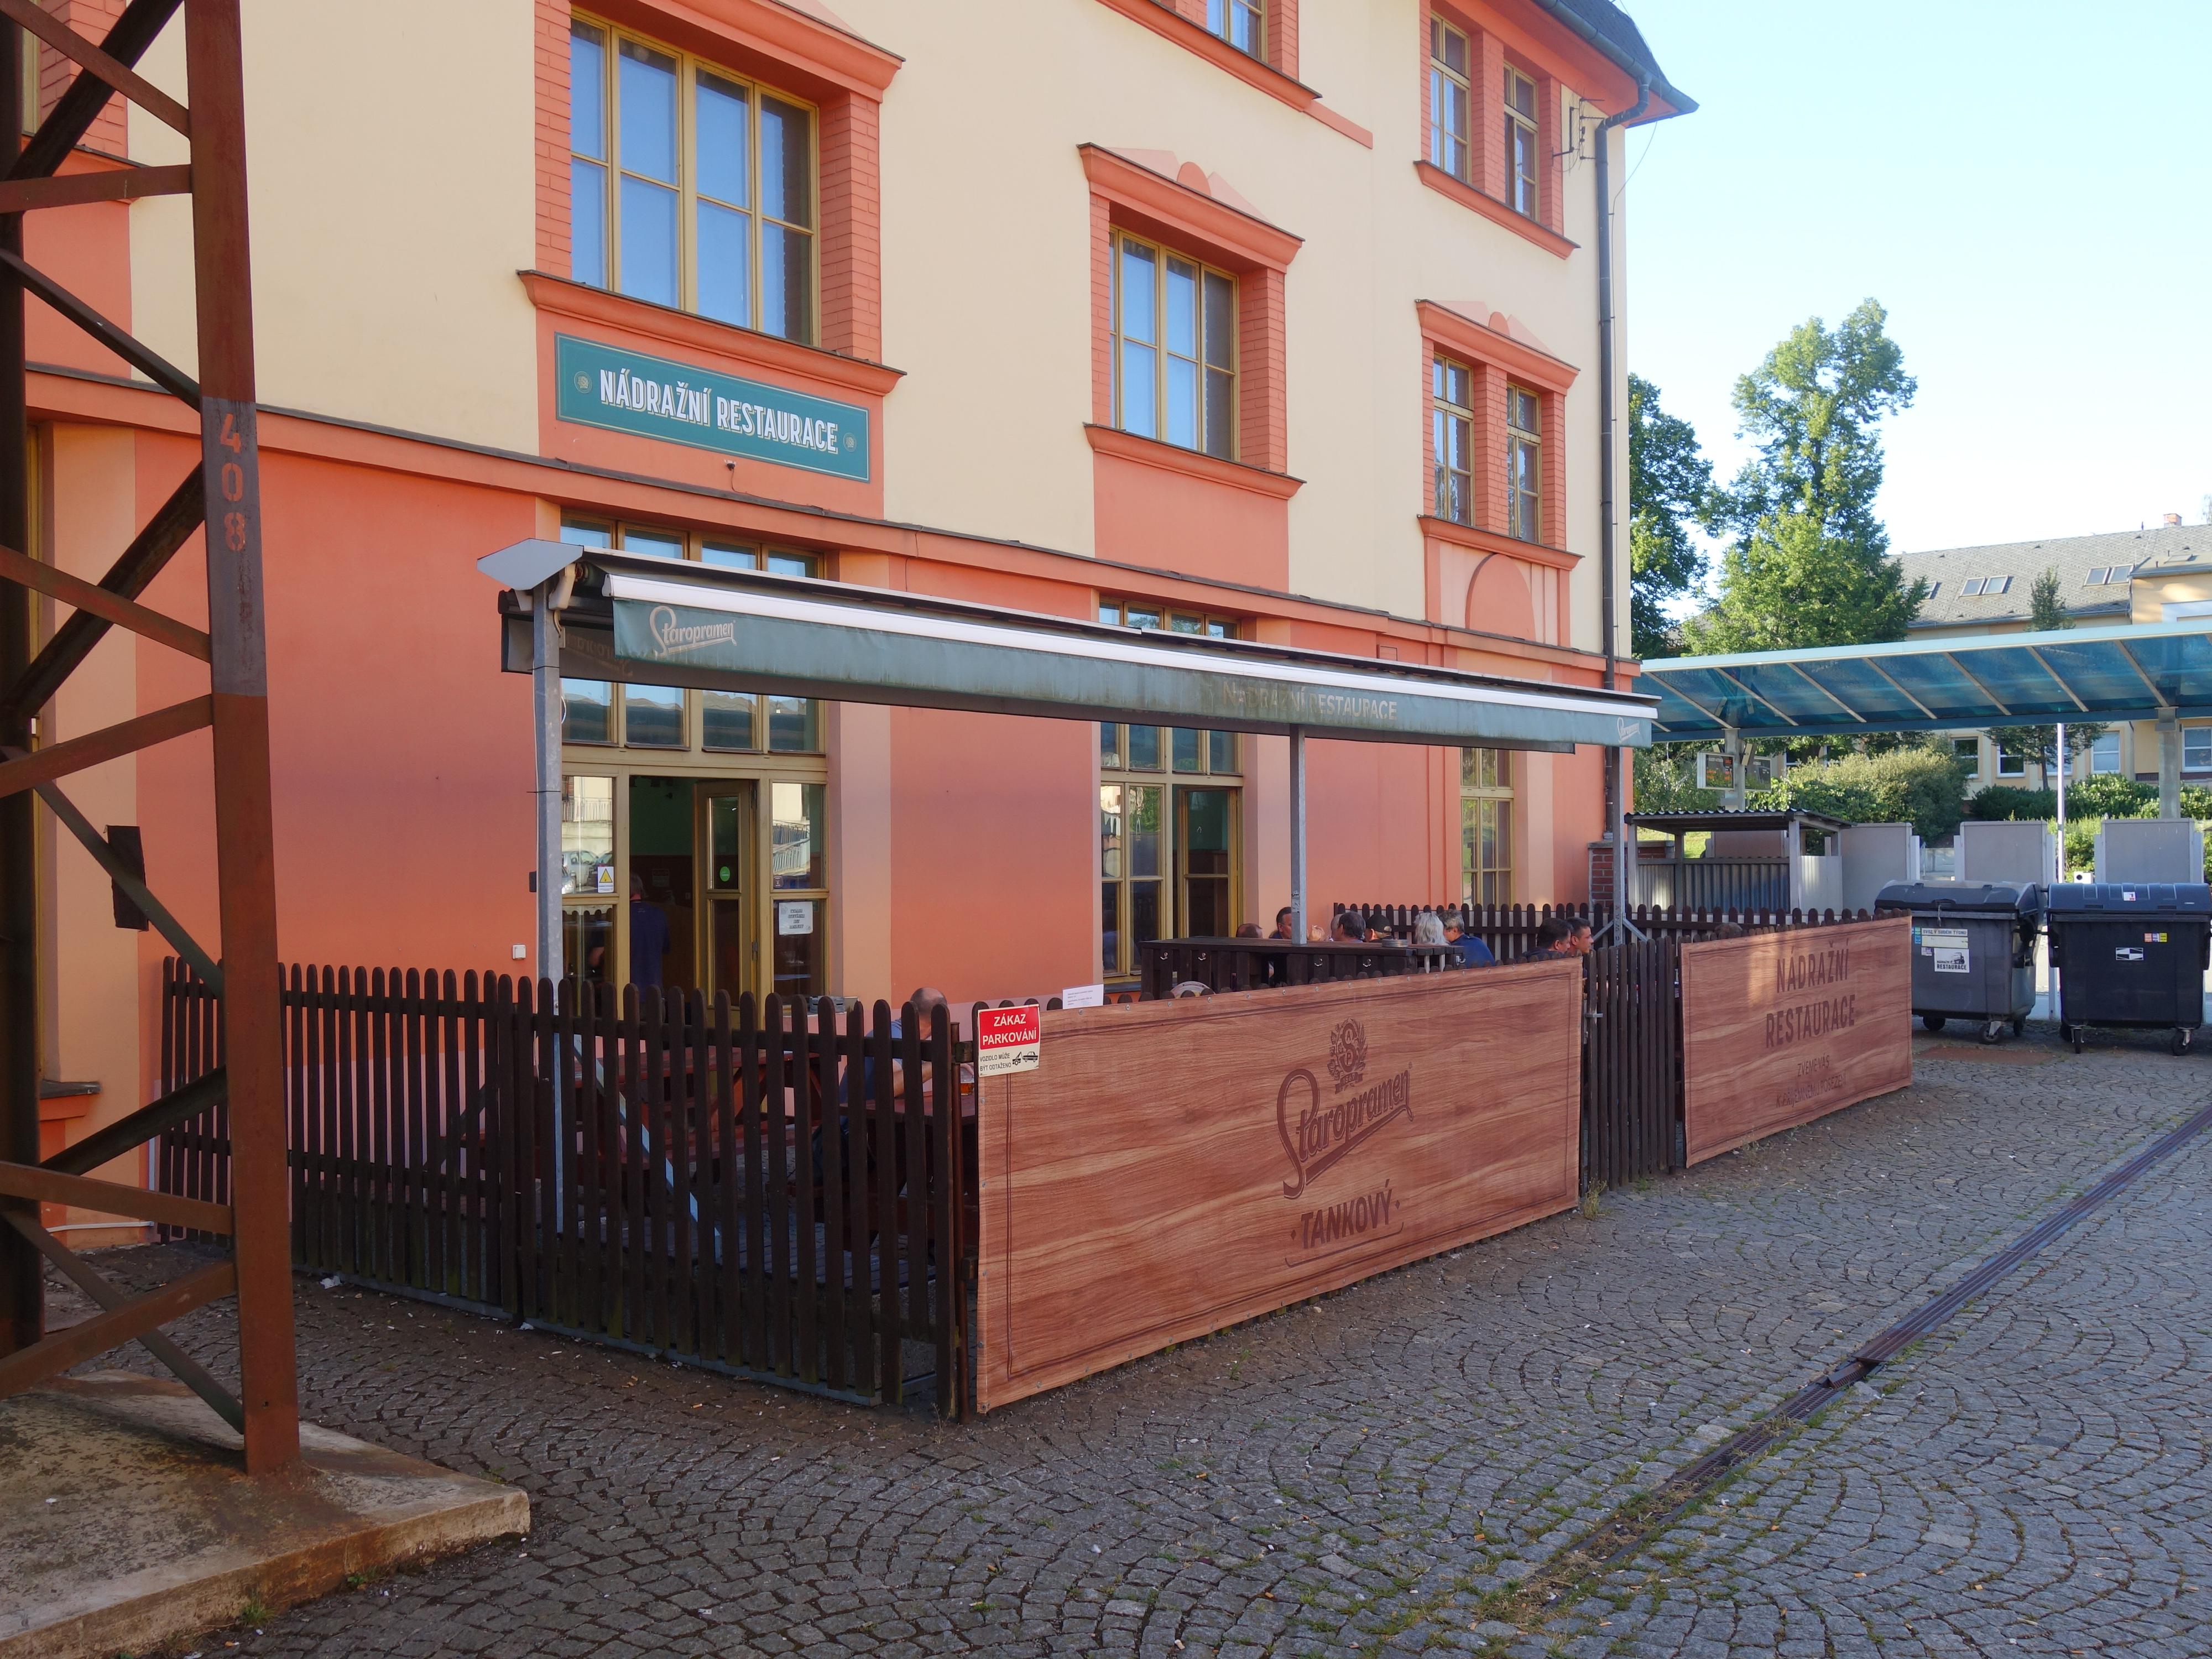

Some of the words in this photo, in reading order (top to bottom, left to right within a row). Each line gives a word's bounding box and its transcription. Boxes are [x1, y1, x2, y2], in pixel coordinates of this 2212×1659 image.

[601, 368, 711, 427] NÁDRAŽNÍ
[717, 397, 838, 454] RESTAURACE
[220, 413, 247, 552] 408
[649, 606, 737, 656] Staropramen
[1309, 693, 1398, 721] RESTAURACE
[1777, 938, 1849, 993] NÁDRAŽNÍ
[982, 1027, 1037, 1046] PARKOVÁNÍ
[993, 1013, 1026, 1027] ZÁKAZ
[1766, 994, 1856, 1048] RESTAURACE
[989, 1062, 1011, 1071] ODTAŽENO
[1797, 1057, 1818, 1077] ZVEME
[1818, 1053, 1830, 1070] VÁS
[1277, 1068, 1414, 1199] Staropramen
[1300, 1178, 1392, 1249] TANKOVÝ
